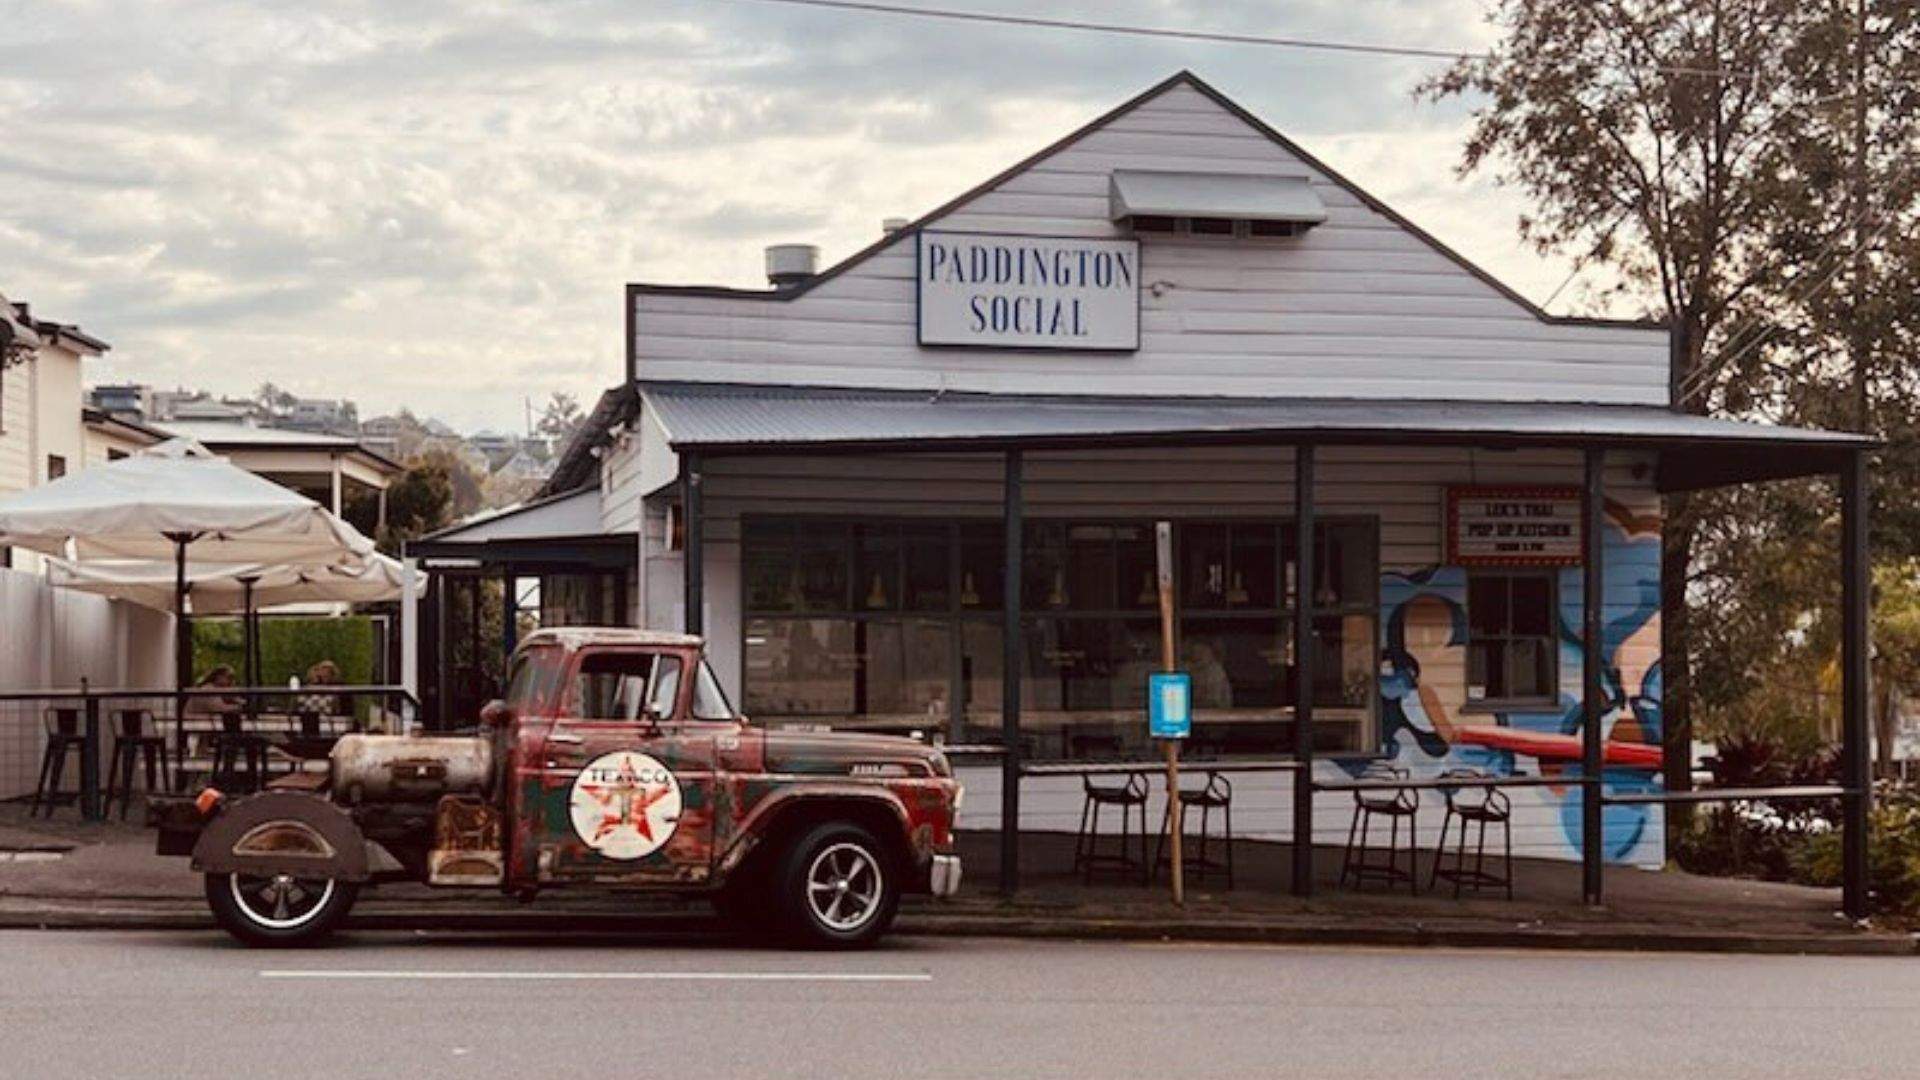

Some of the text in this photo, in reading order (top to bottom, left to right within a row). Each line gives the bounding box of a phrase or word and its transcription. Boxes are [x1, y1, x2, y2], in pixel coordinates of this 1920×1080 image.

[929, 243, 1133, 287] PADDINGTON
[970, 295, 1088, 336] SOCIAL
[1468, 523, 1571, 537] POP UP KITCHEN
